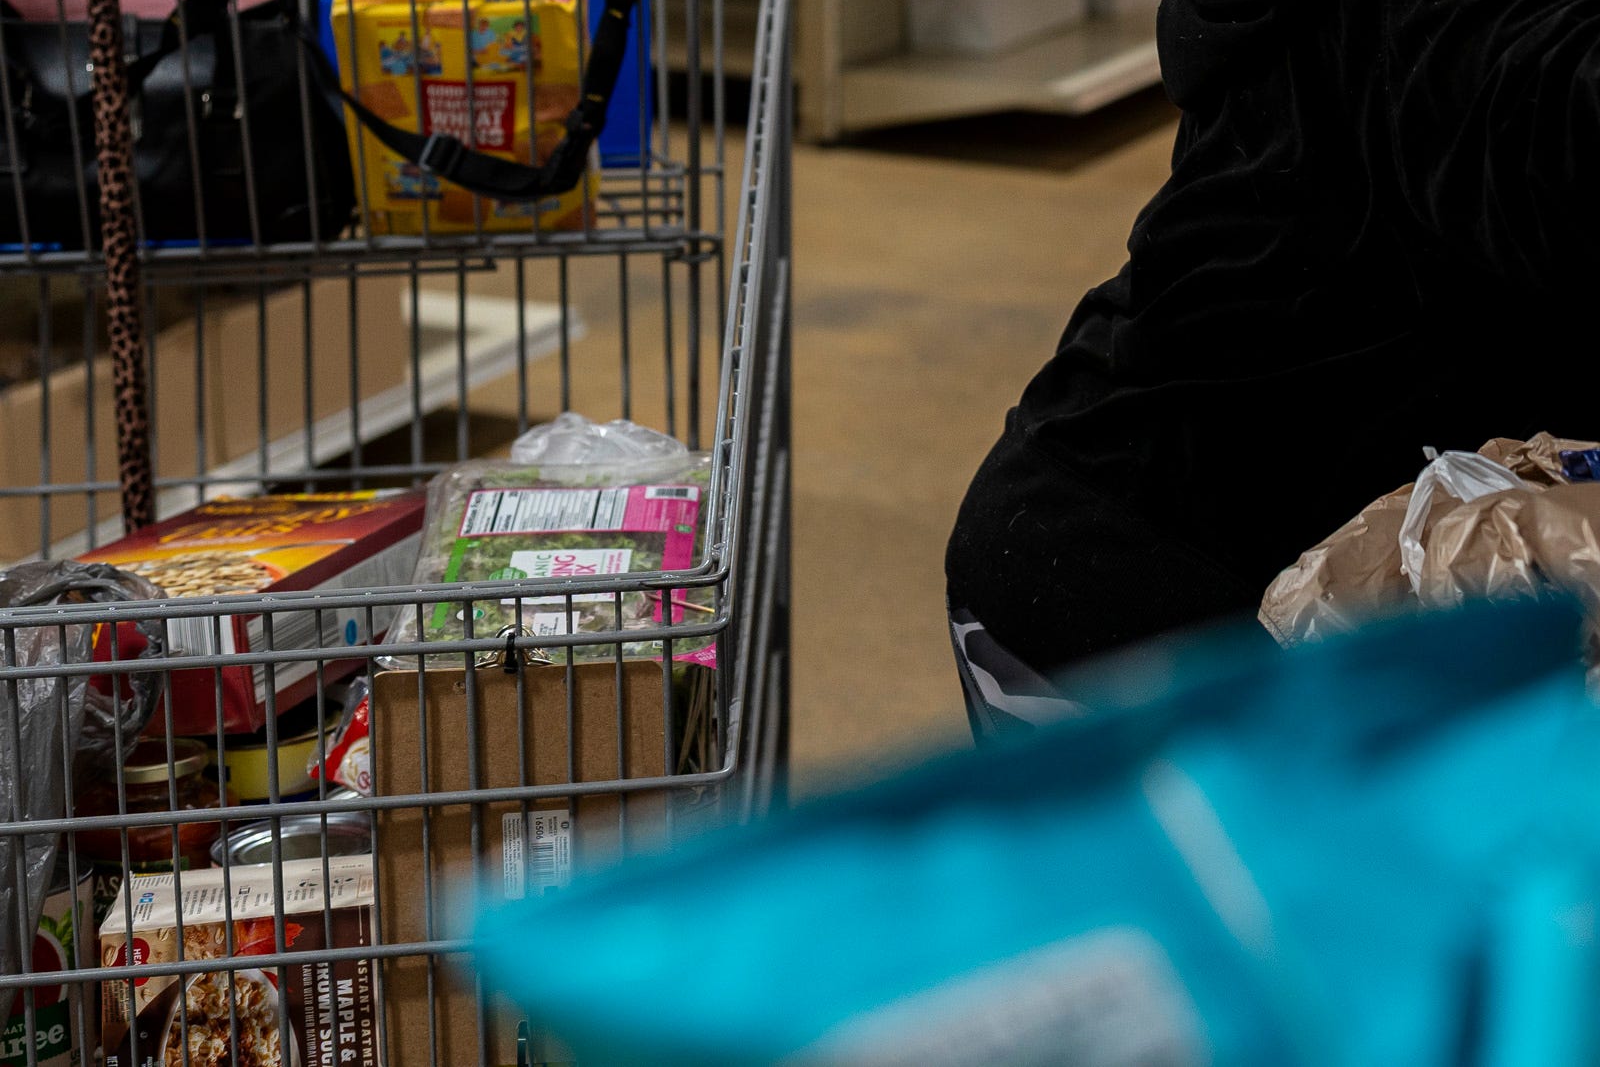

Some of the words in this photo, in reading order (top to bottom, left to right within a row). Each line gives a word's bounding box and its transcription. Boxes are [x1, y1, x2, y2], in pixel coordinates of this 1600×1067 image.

[535, 816, 545, 840] 16506
[133, 948, 142, 966] HEA
[302, 963, 313, 987] LAVOR
[357, 959, 370, 1013] NSTANT
[336, 978, 356, 1044] MAPLE
[320, 1028, 334, 1067] SUG
[340, 1048, 357, 1063] &
[360, 1019, 373, 1067] OATME
